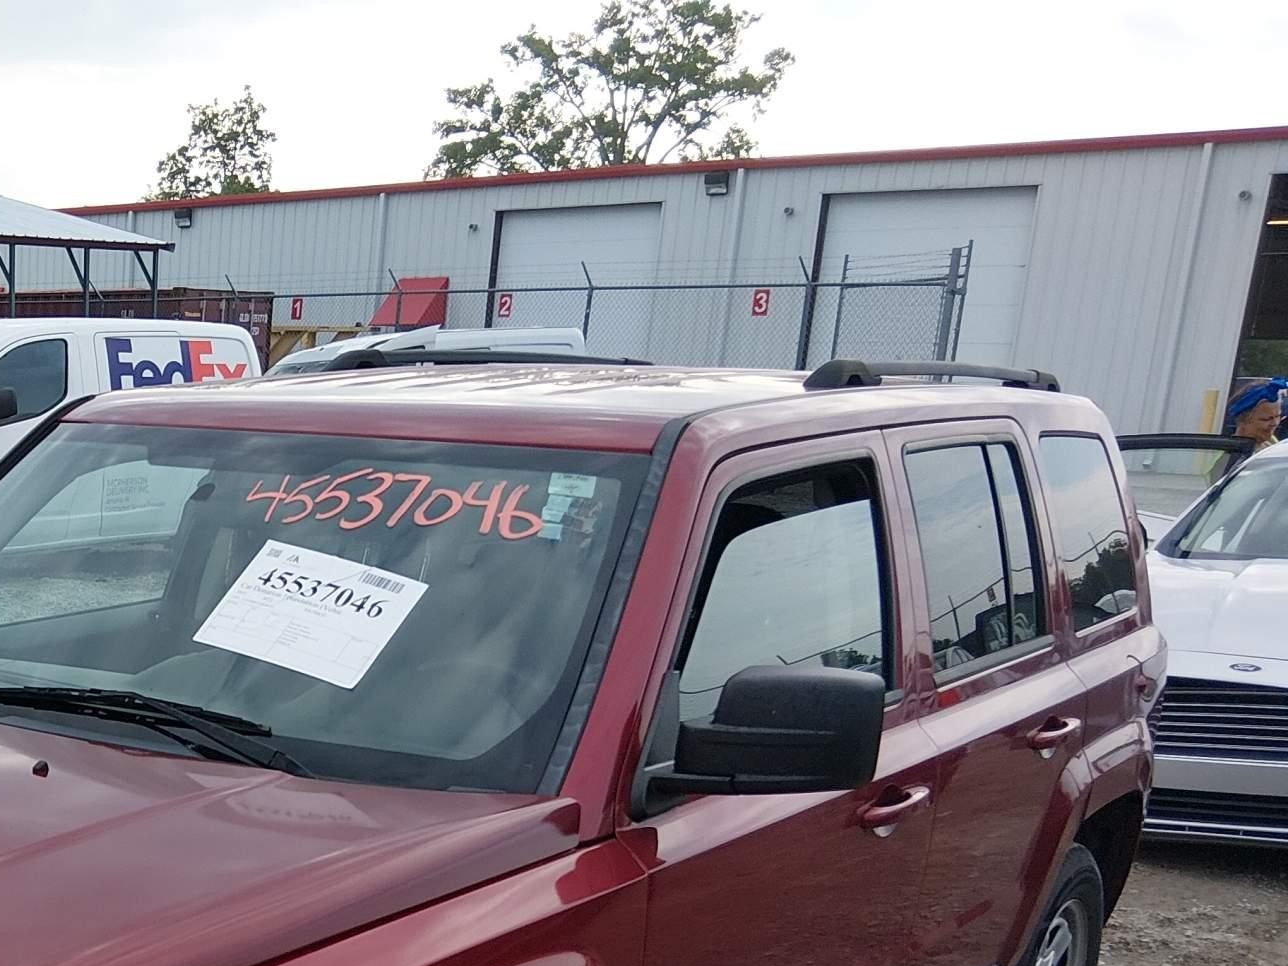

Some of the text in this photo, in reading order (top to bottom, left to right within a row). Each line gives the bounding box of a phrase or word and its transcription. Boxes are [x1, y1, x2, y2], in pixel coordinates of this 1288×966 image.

[293, 300, 301, 317] 1
[498, 296, 511, 315] 2
[753, 292, 767, 313] 3
[105, 337, 247, 391] FedEx
[246, 469, 544, 541] 45537046
[258, 567, 390, 619] 45537046
